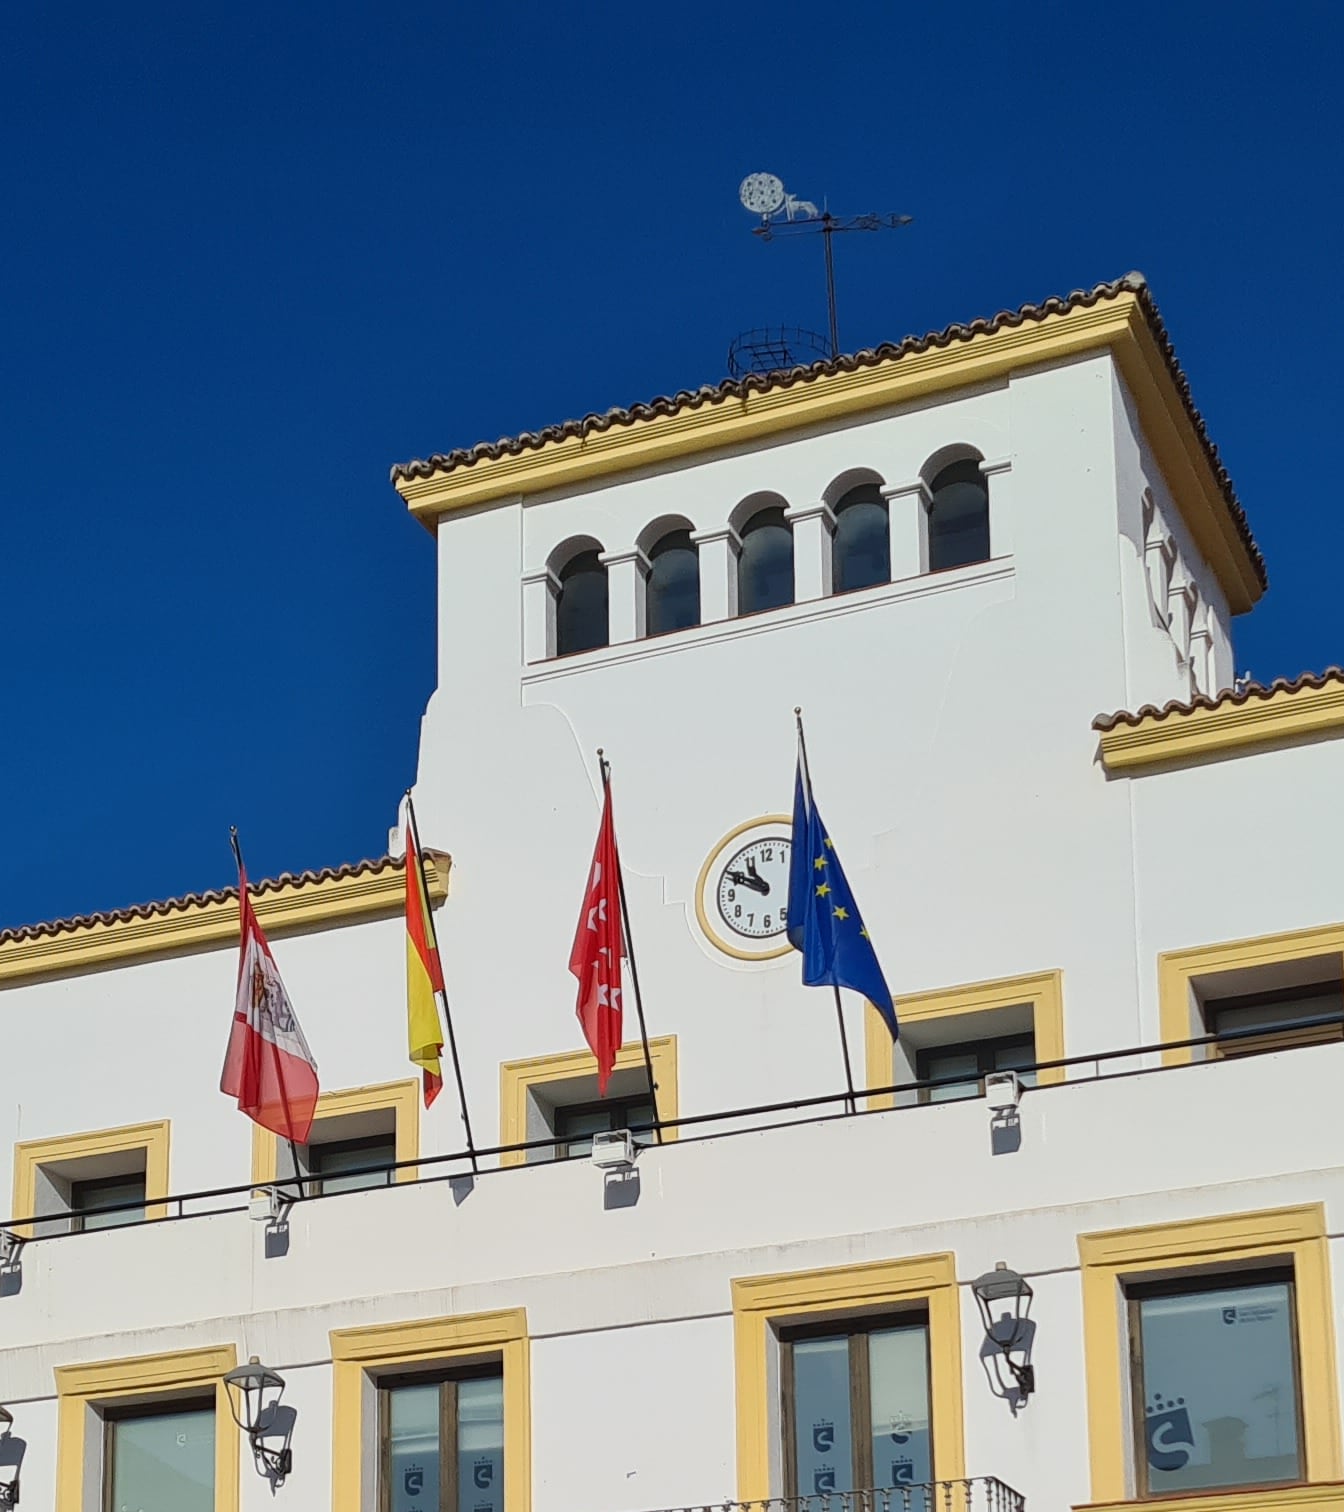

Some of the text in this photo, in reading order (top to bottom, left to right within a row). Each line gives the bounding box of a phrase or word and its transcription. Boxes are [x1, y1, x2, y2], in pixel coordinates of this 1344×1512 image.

[760, 847, 773, 863] 12
[779, 850, 786, 864] 1
[727, 888, 736, 902] 9
[734, 904, 742, 918] 8
[779, 907, 788, 921] 5
[746, 913, 755, 927] 7
[763, 914, 772, 928] 6
